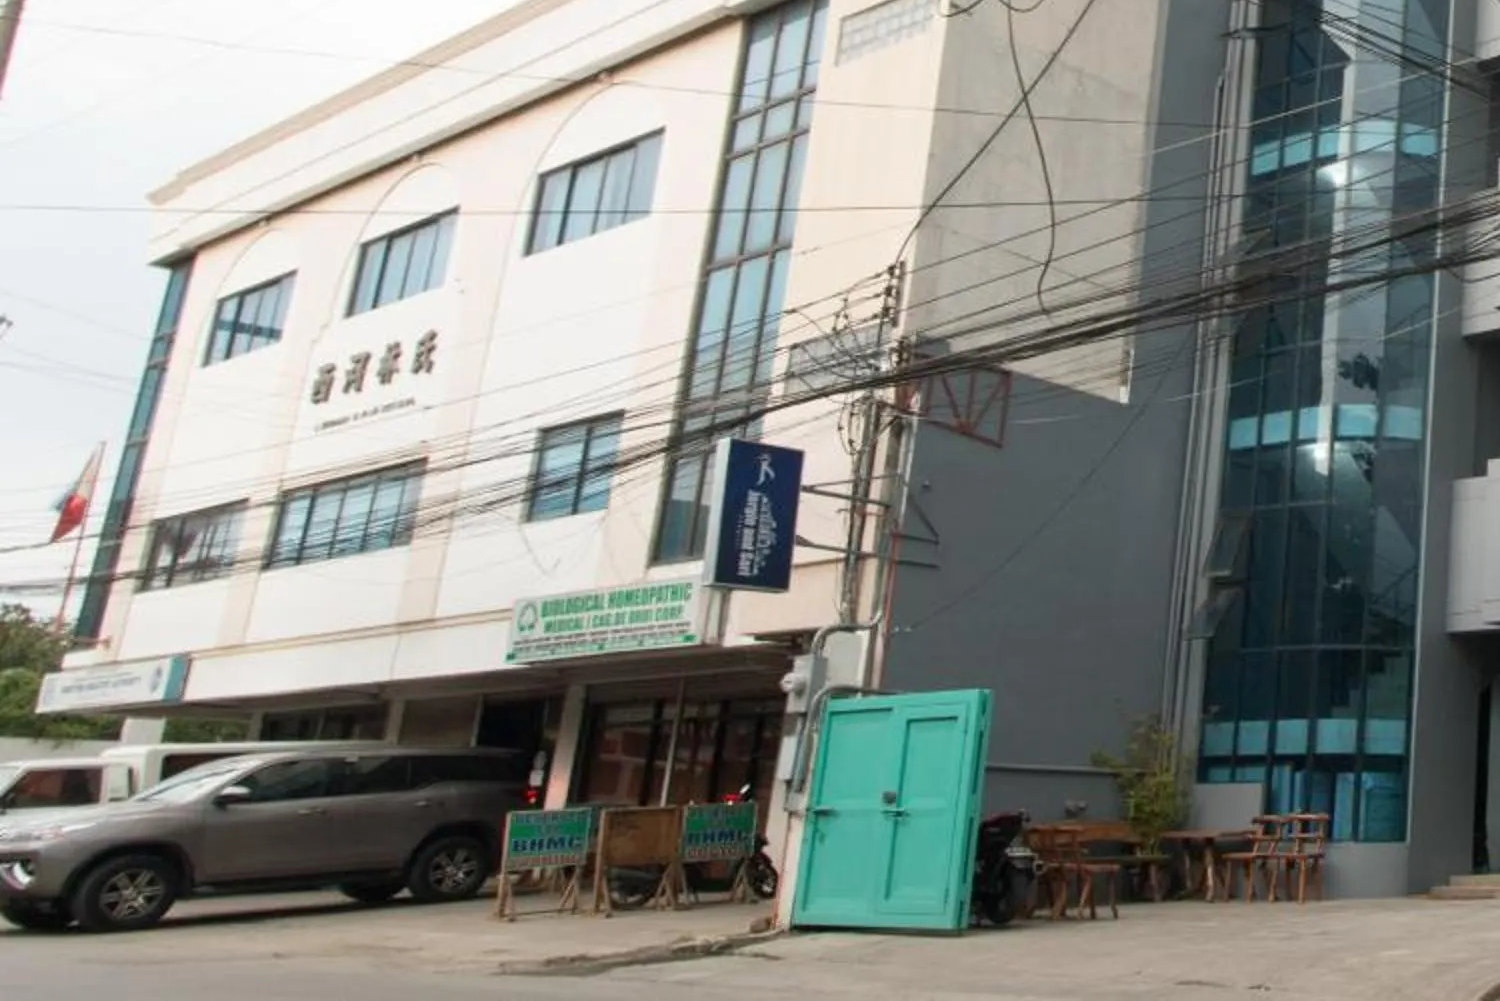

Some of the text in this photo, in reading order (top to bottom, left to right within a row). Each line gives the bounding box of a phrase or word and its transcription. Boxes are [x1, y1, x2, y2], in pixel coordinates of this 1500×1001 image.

[541, 582, 693, 618] BIOLOGICAL HOMEOPATHIC
[544, 615, 585, 633] MEDICAL
[512, 836, 583, 853] BHMC
